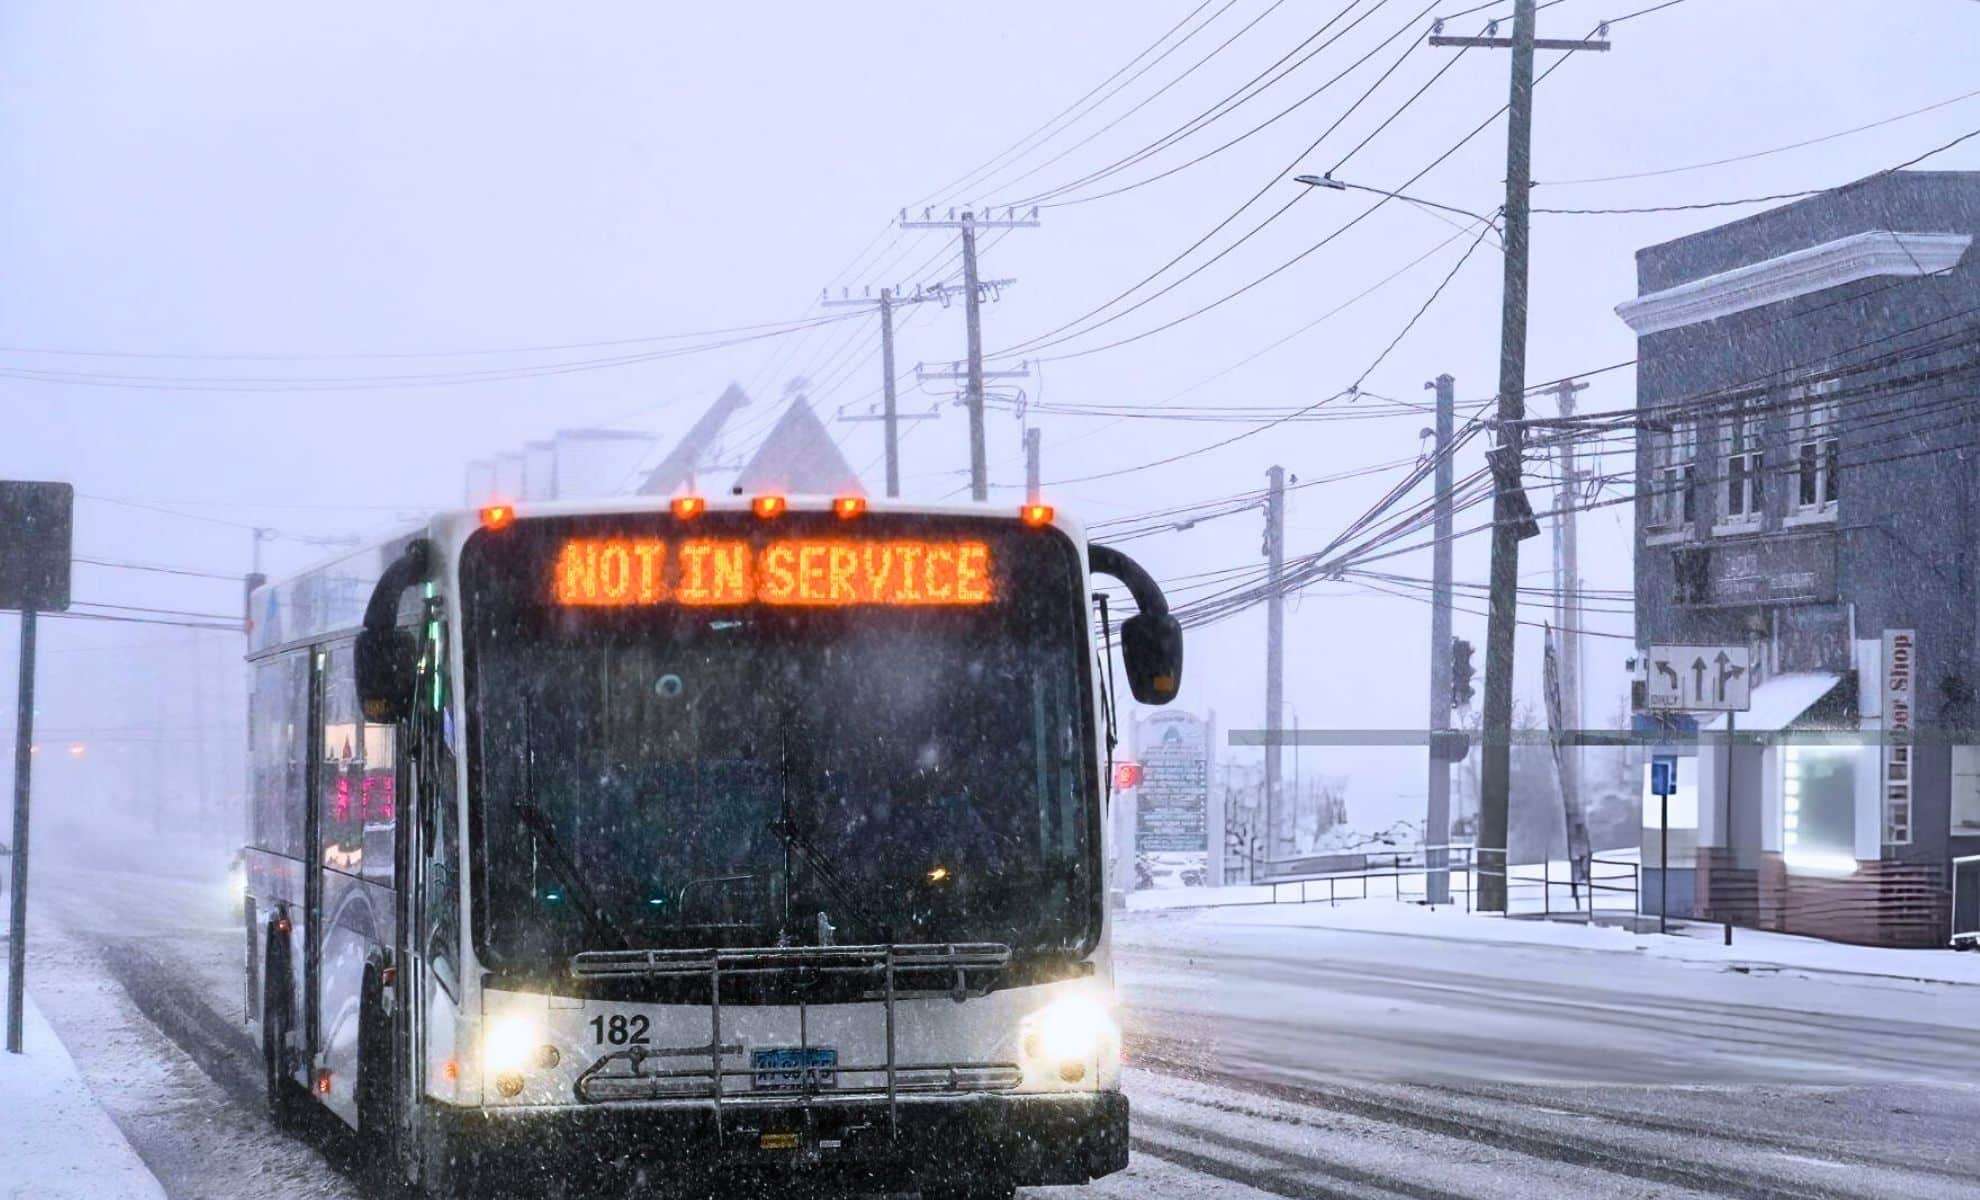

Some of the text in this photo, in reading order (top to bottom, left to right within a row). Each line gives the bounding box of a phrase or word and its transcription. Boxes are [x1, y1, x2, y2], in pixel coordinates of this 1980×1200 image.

[564, 541, 988, 602] NOT IN SERVICE
[1889, 634, 1913, 691] Shop
[589, 1014, 650, 1046] 182
